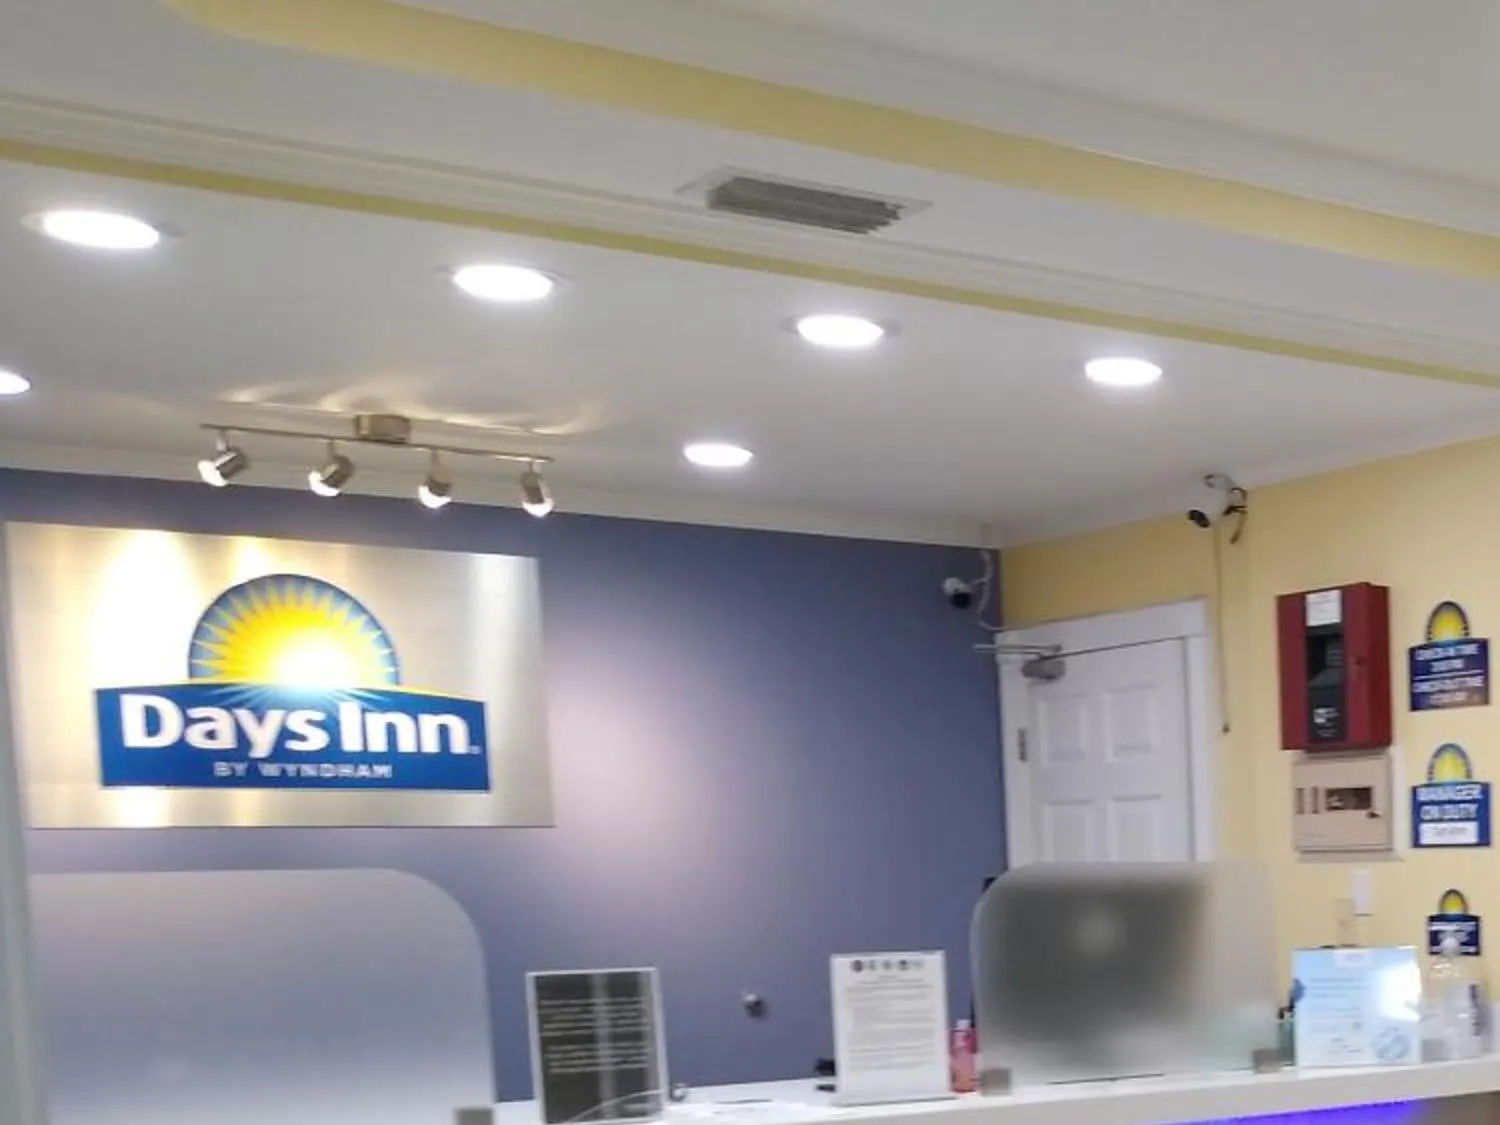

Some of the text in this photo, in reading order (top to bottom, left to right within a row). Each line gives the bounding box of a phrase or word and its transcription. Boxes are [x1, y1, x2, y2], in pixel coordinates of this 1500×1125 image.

[119, 693, 331, 759] Days
[213, 761, 394, 779] BY WYNDHAM
